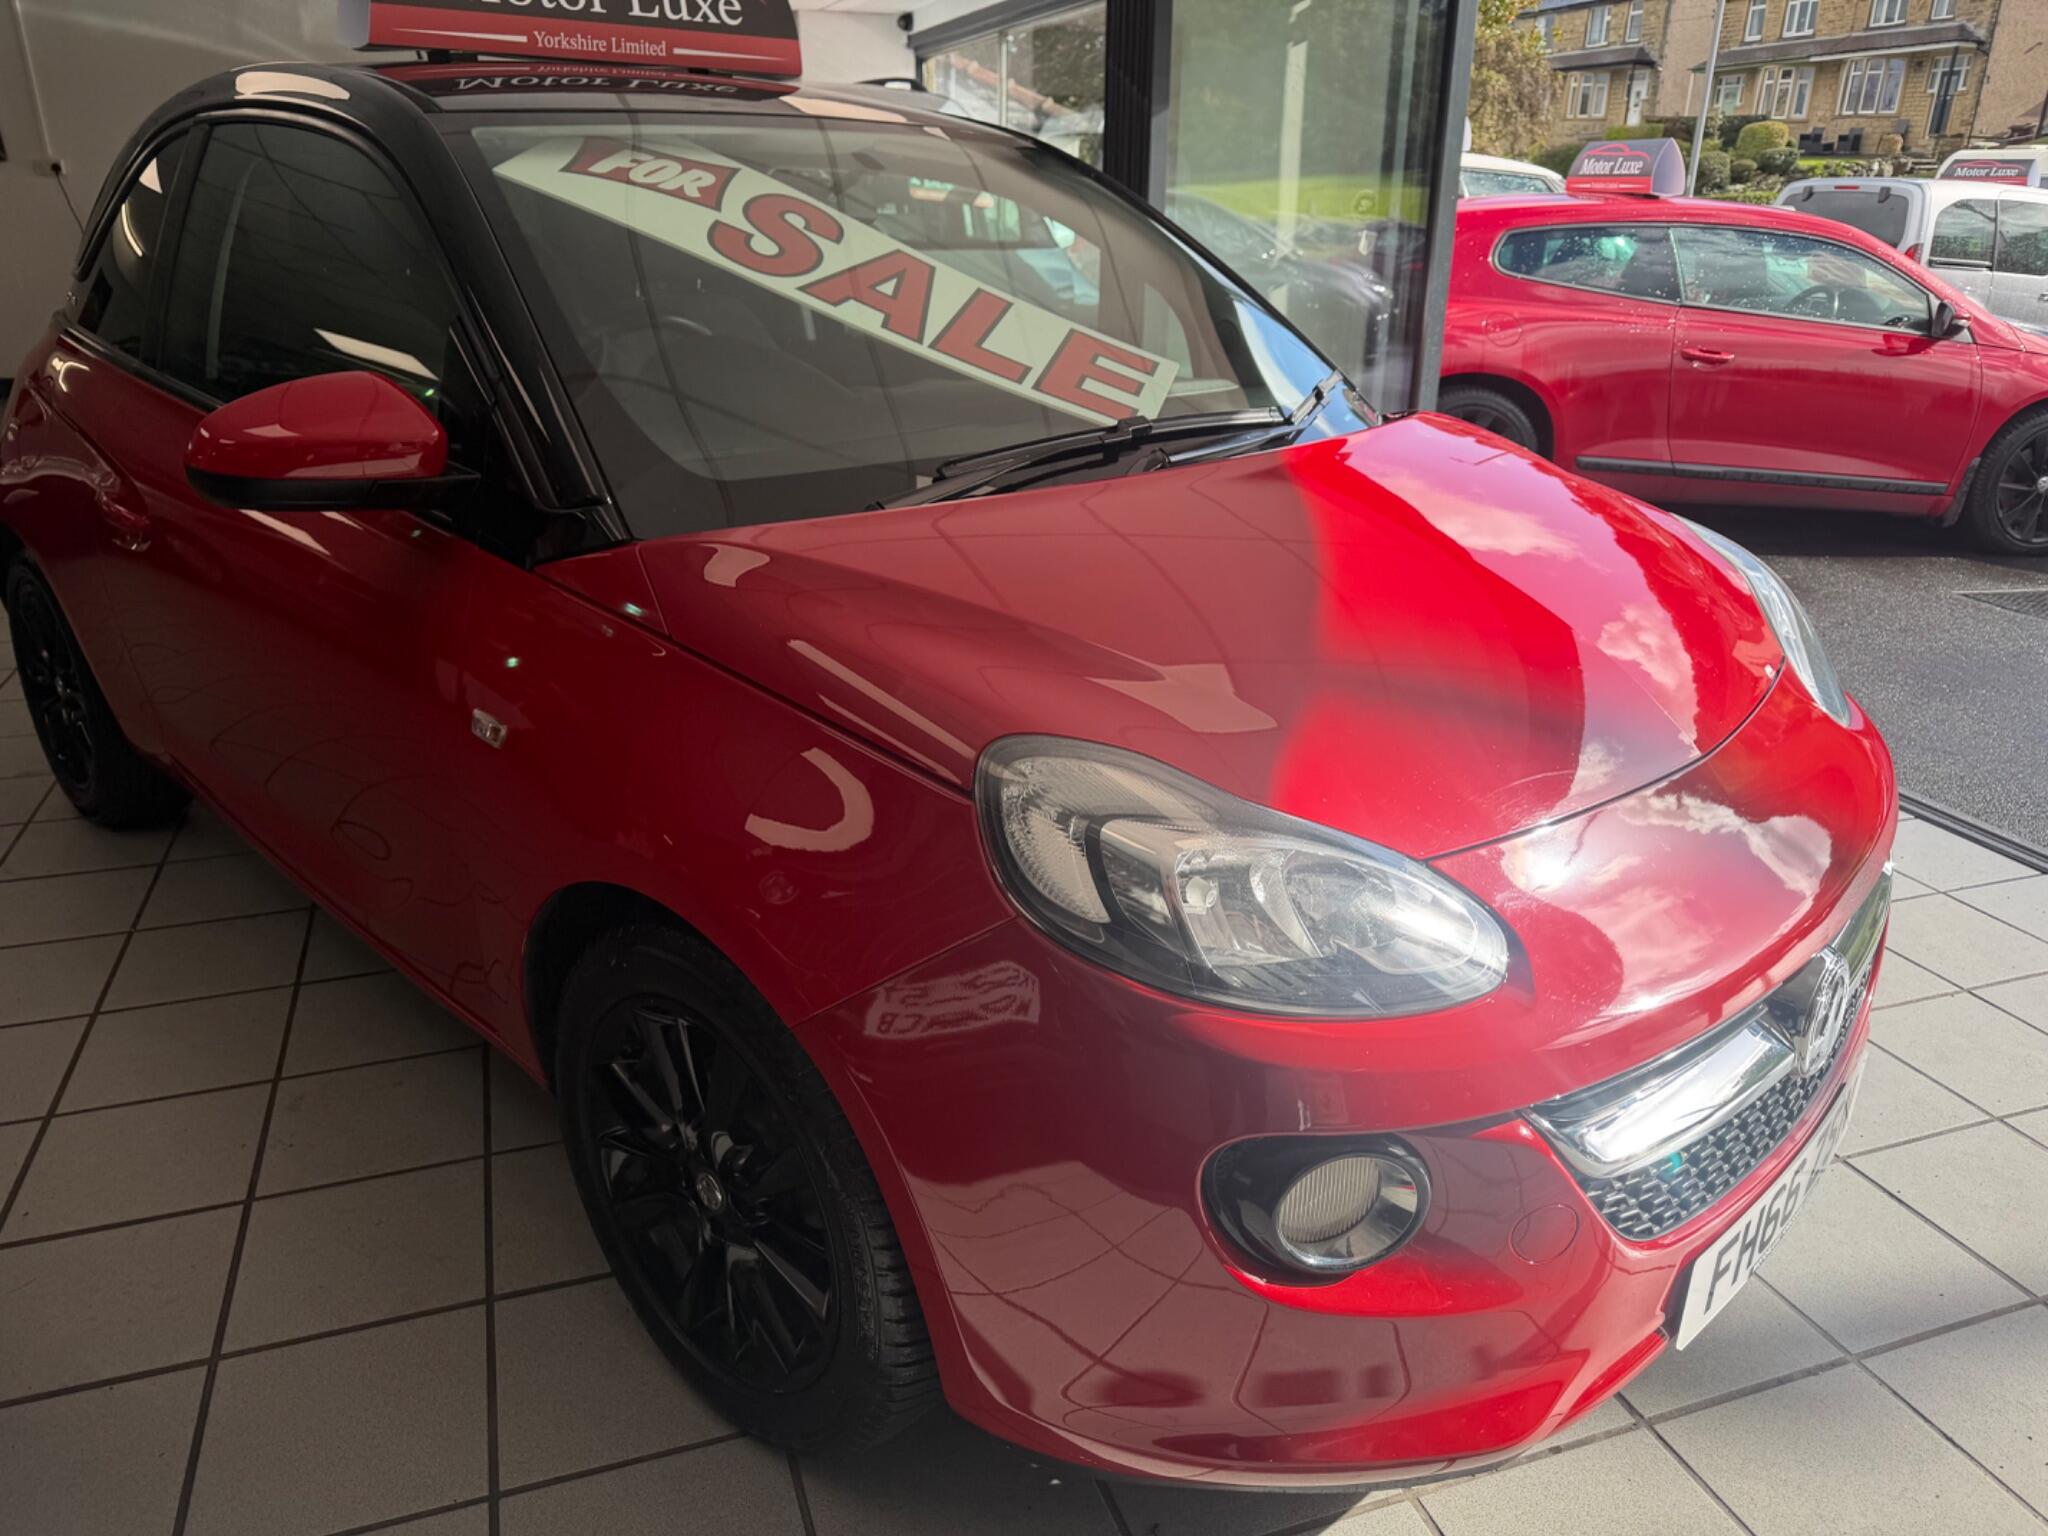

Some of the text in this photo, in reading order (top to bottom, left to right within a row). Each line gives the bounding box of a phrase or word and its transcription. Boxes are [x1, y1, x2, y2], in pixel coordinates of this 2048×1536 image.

[533, 30, 667, 57] Yorkshire Limited
[588, 149, 717, 198] FOR
[1579, 157, 1644, 175] Motor Luxe
[1954, 167, 2019, 177] Motor Luxe
[707, 192, 1160, 420] SALE
[1703, 1156, 1808, 1316] FH66
